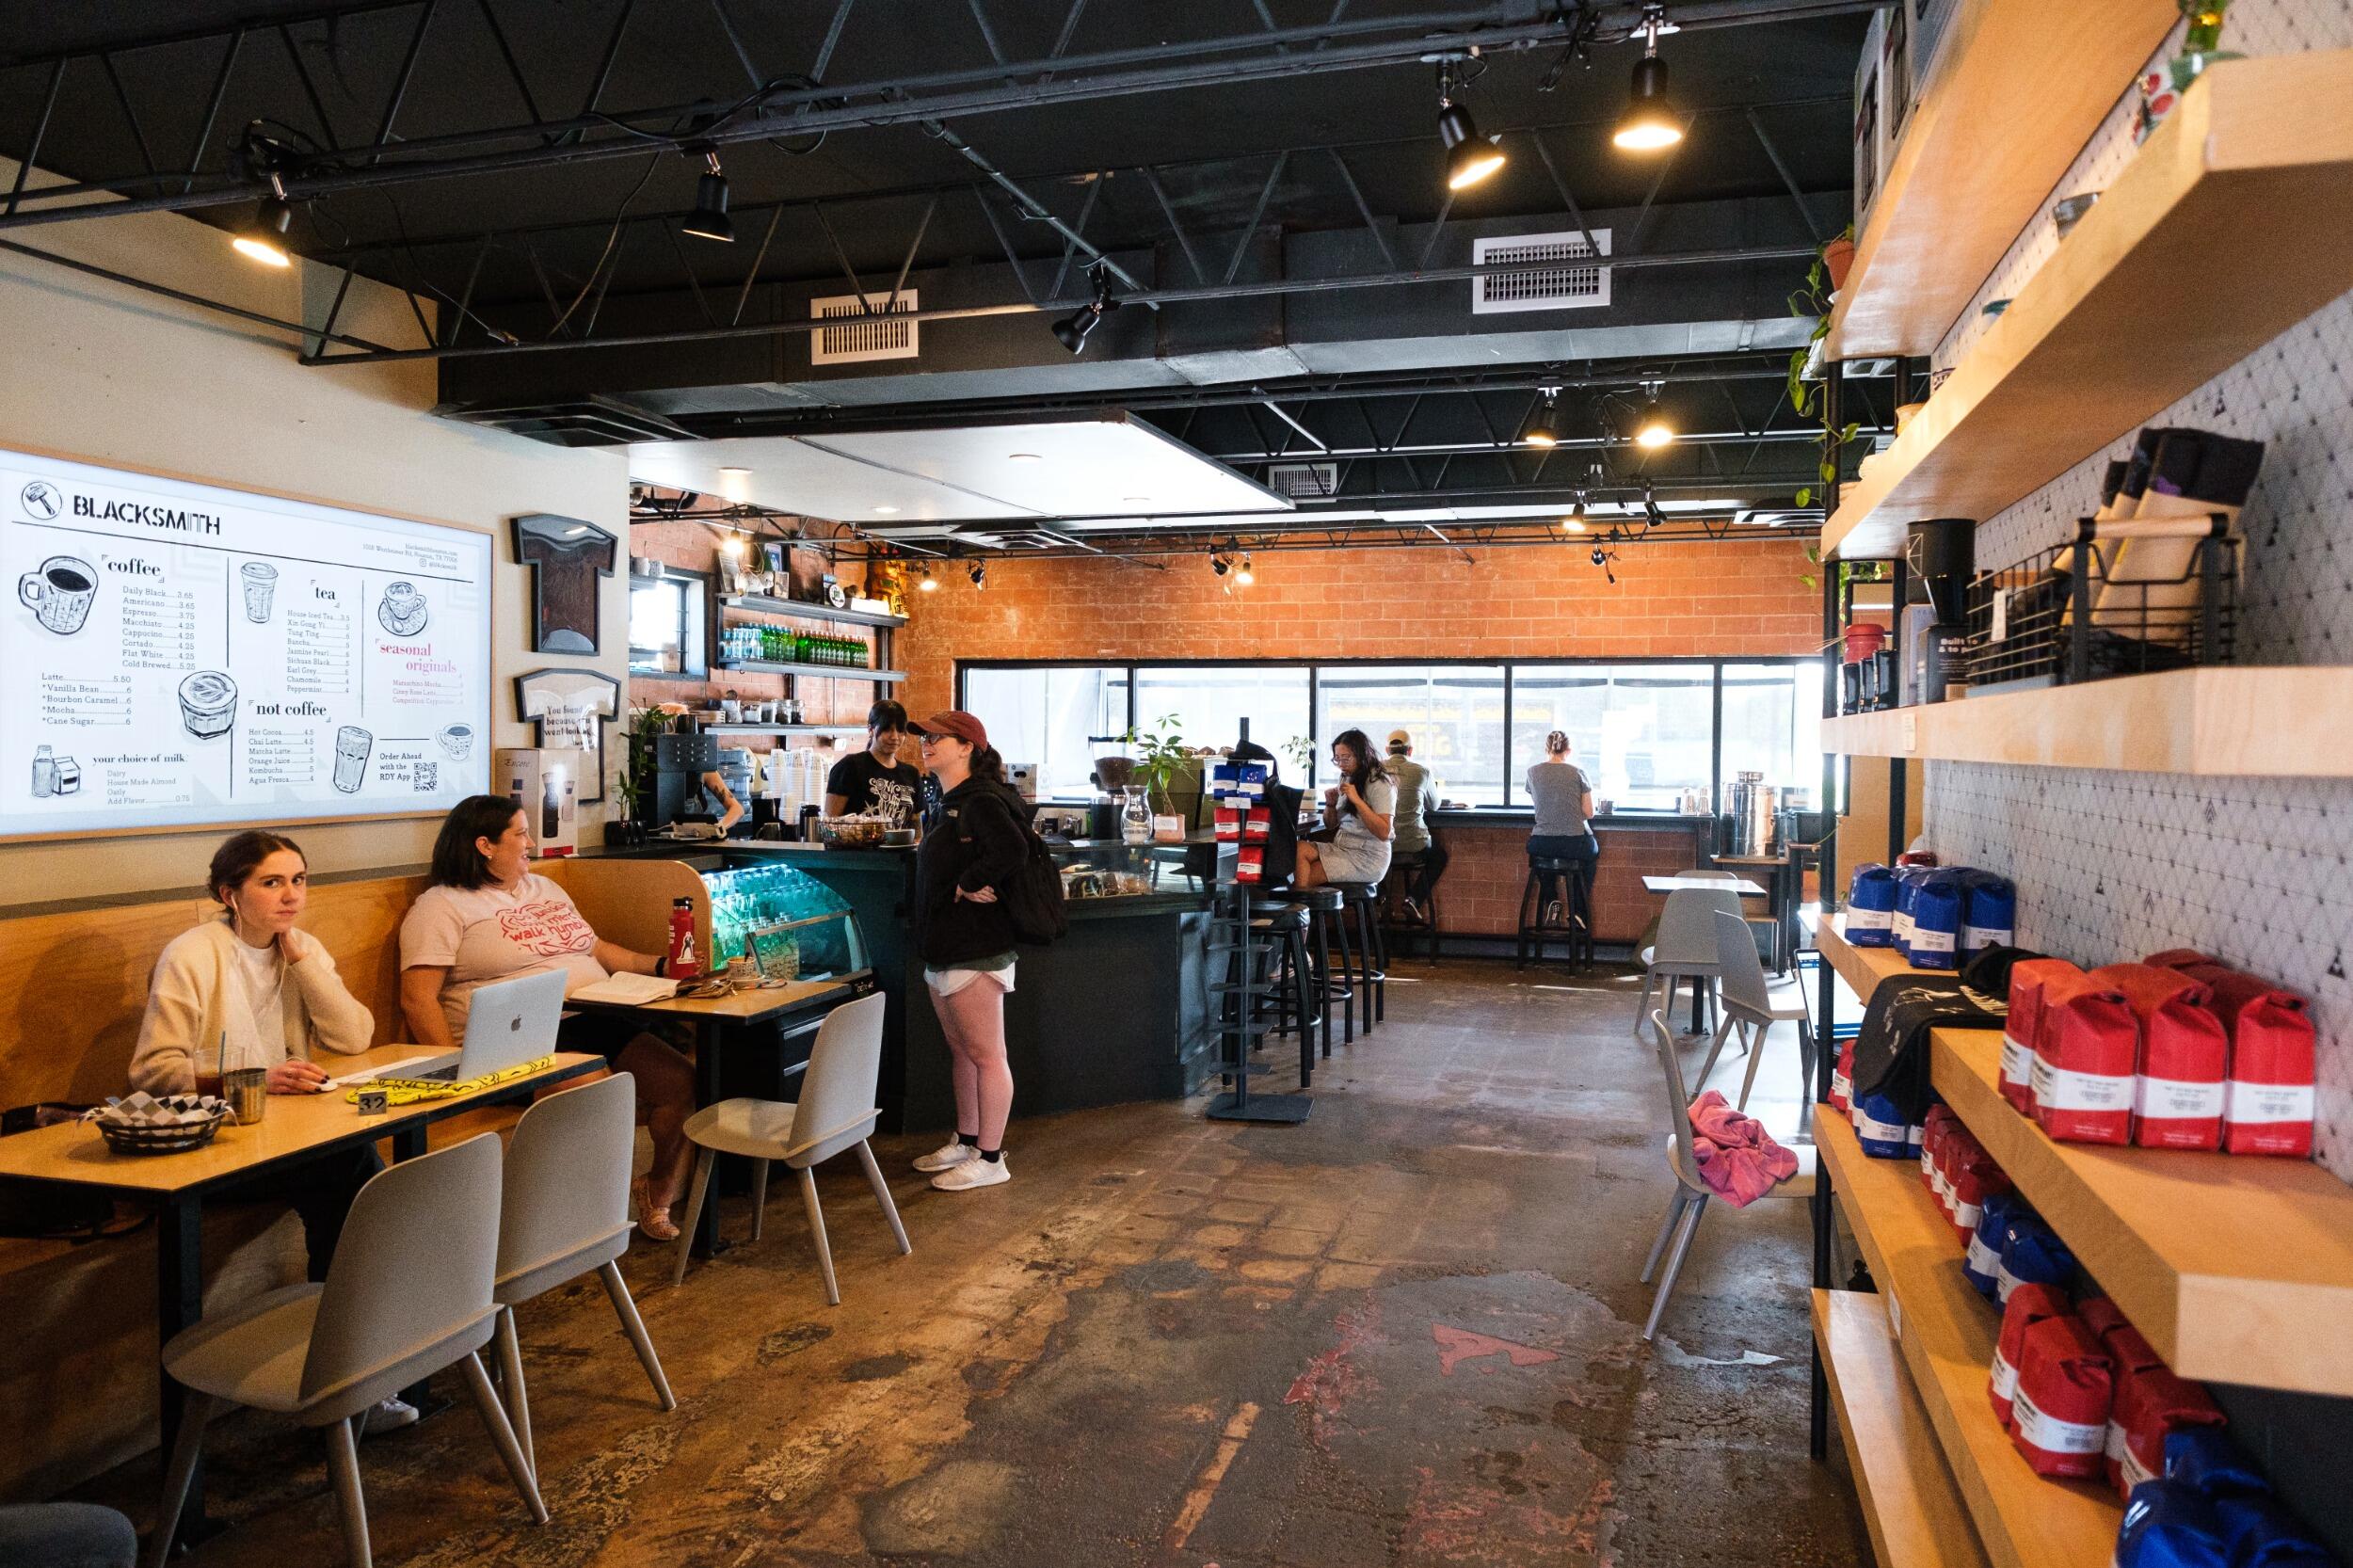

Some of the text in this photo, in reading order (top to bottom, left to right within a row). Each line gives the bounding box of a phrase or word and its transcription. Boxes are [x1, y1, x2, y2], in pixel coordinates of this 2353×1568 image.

[73, 495, 220, 536] BLACKSMITH
[108, 558, 160, 576] coffee
[123, 585, 143, 596] Daily
[145, 588, 166, 597] Black
[316, 587, 336, 600] tea
[123, 597, 165, 607] Americano
[123, 608, 157, 617] Espresso
[122, 617, 162, 628] Macchiato
[122, 639, 153, 648] Cortado
[141, 649, 163, 659] White
[380, 644, 431, 656] seasonal
[143, 661, 170, 669] Brewed
[407, 659, 456, 677] originals
[41, 672, 64, 680] Latte
[256, 700, 327, 716] not coffee
[547, 705, 584, 715] You found
[71, 717, 94, 727] Sugar
[545, 728, 564, 736] went
[92, 753, 184, 766] your choice of milk
[248, 757, 272, 765] Orange
[504, 759, 531, 768] Encore
[107, 770, 126, 778] Dairy
[397, 774, 411, 782] App
[509, 928, 545, 941] walk
[360, 1096, 385, 1111] 32
